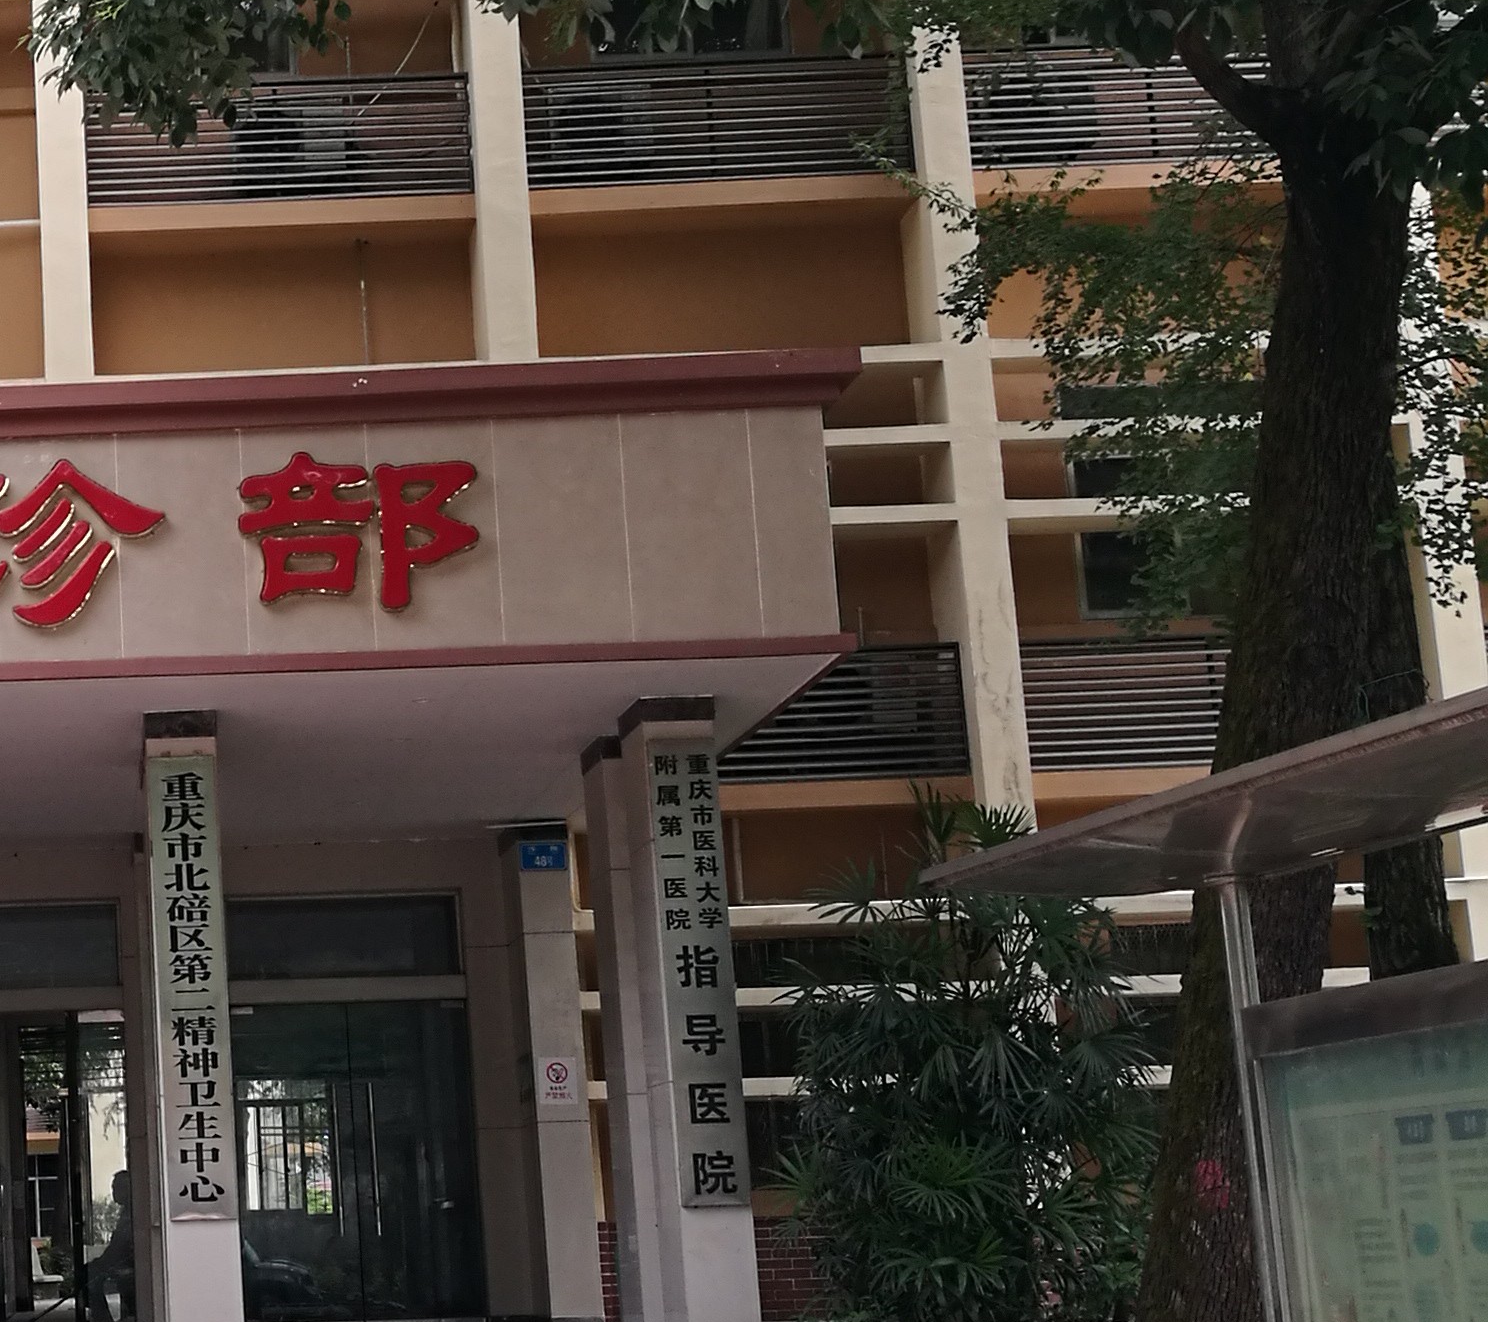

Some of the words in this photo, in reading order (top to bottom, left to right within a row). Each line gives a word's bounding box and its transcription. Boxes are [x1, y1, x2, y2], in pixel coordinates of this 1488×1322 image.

[654, 755, 691, 930] 附属第一医院
[687, 754, 723, 929] 重庆市医科大学
[159, 772, 225, 1203] 重庆市北碚区第二精神卫生中心
[676, 944, 737, 1196] 指导医院
